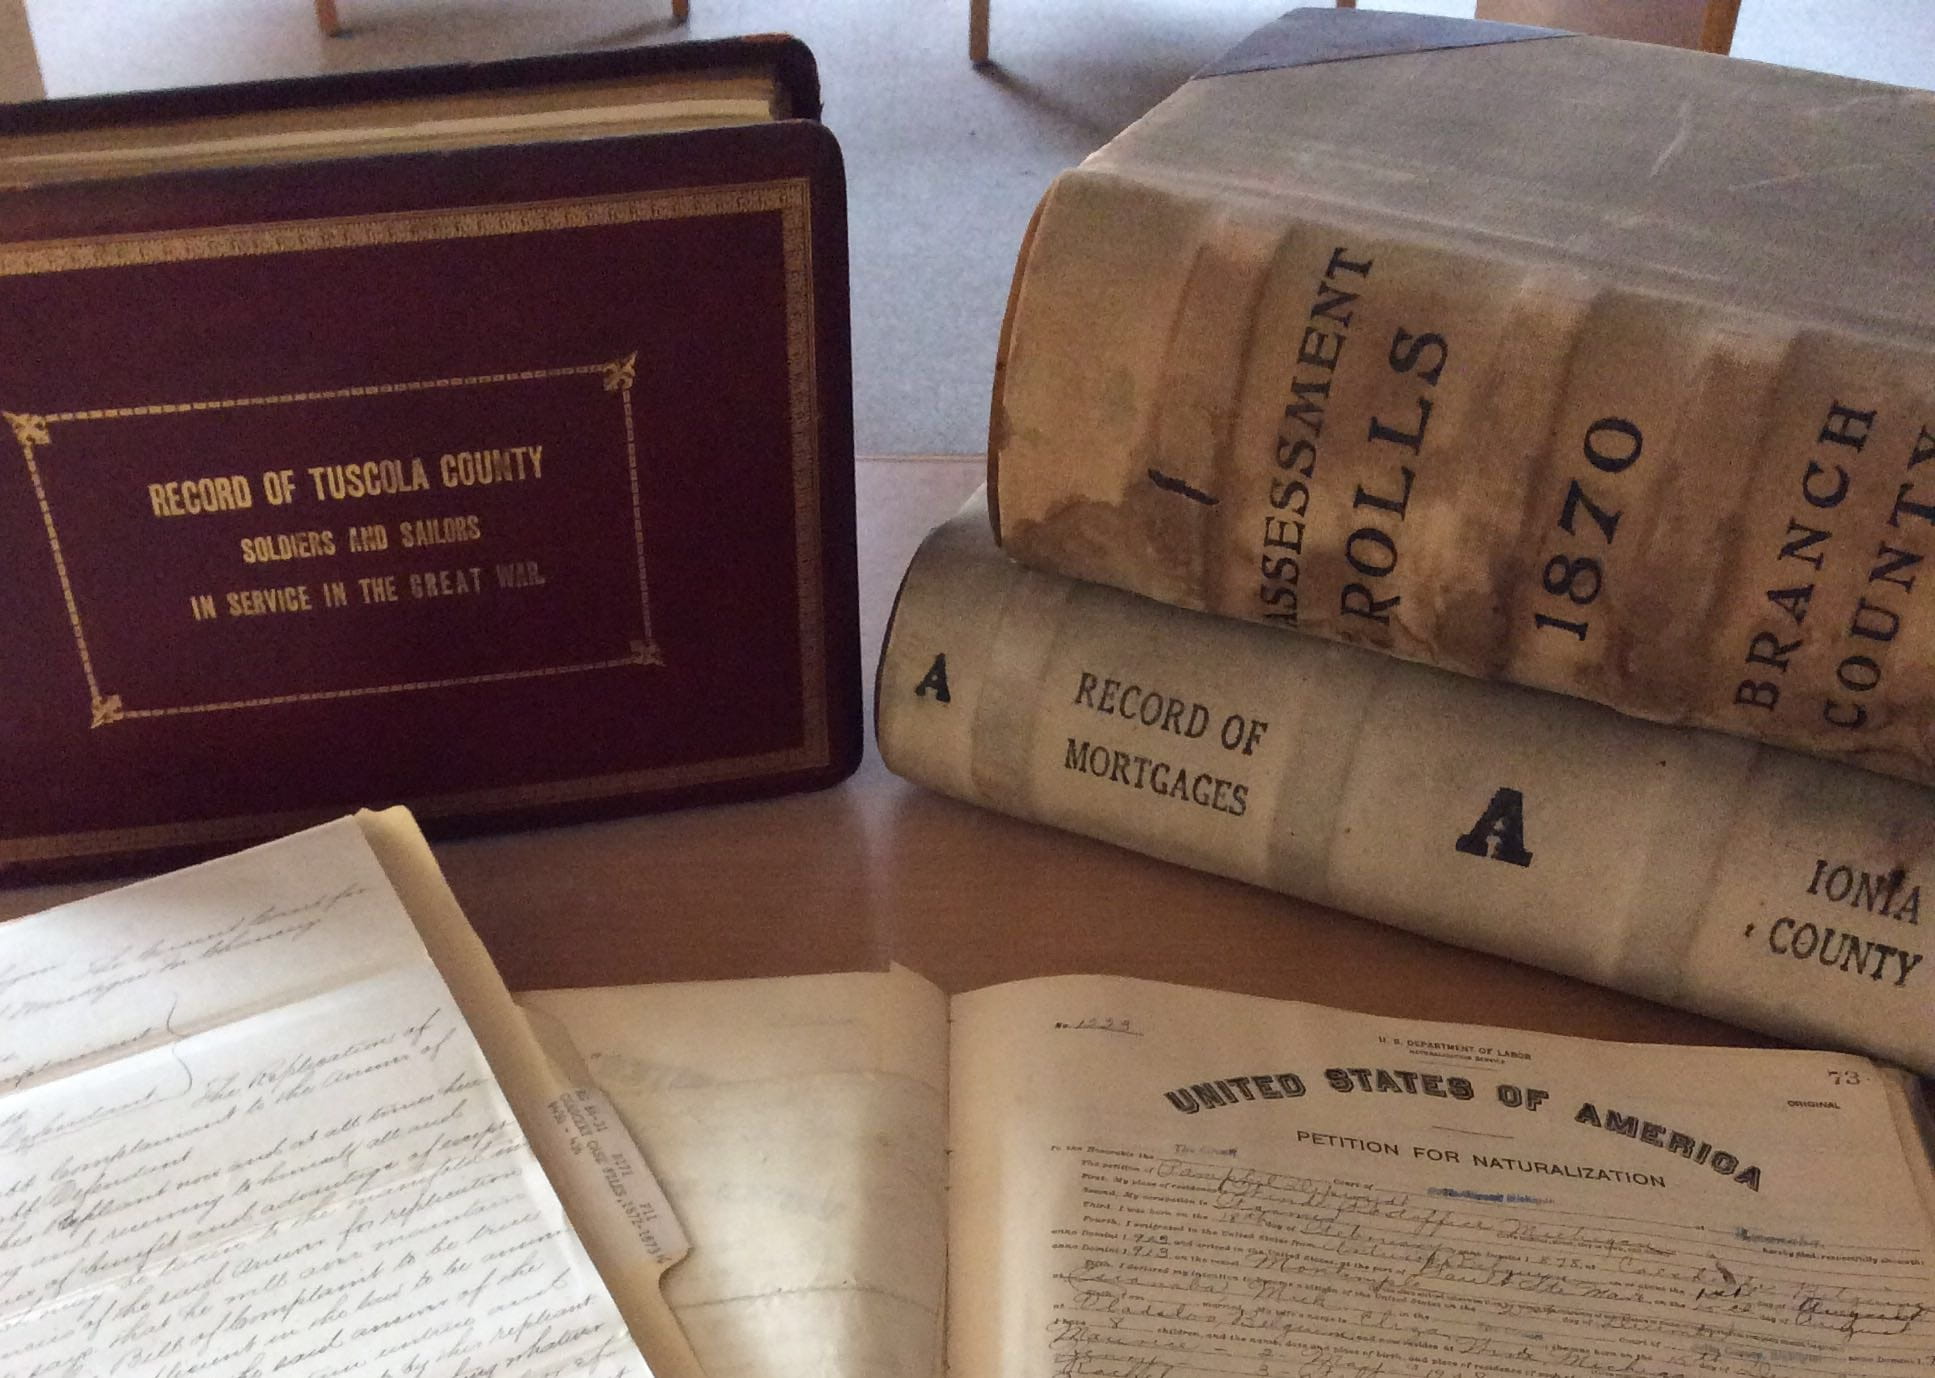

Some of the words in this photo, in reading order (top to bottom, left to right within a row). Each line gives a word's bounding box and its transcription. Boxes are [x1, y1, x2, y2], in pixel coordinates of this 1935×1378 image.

[1260, 246, 1373, 628] ASSESSMENT
[148, 475, 252, 517] RECORD
[263, 470, 296, 505] OF
[308, 458, 430, 501] TUSCOLA
[440, 446, 543, 487] COUNTY
[1341, 327, 1449, 626] ROLLS
[241, 531, 336, 564] SOLDIERS
[349, 525, 389, 553] AND
[401, 515, 481, 548] SAILORS
[1534, 416, 1644, 642] 1870
[1733, 400, 1878, 713] BRANCH
[191, 594, 217, 621] IN
[229, 586, 312, 617] SERVICE
[324, 582, 348, 608] IN
[359, 576, 399, 603] THE
[410, 567, 481, 599] GREAT
[914, 652, 951, 704] A
[1074, 671, 1210, 740] RECORD
[1220, 714, 1269, 756] OF
[1064, 738, 1249, 817] MORTGAGES
[1455, 787, 1534, 868] A
[1805, 859, 1922, 926] IONIA
[1768, 916, 1923, 988] COUNTY
[1407, 1039, 1475, 1053] DEPARTMENT
[1478, 1046, 1493, 1056] OF
[1497, 1049, 1532, 1061] LABOR
[1163, 1072, 1307, 1114] UNITED
[1324, 1067, 1475, 1101] STATES
[1496, 1084, 1549, 1111] OF
[1573, 1102, 1763, 1193] AMERICA
[1787, 1100, 1841, 1110] ORIGINAL
[1297, 1130, 1400, 1156] PETITION
[1413, 1147, 1461, 1163] FOR
[1472, 1154, 1667, 1188] NATURALIZATION
